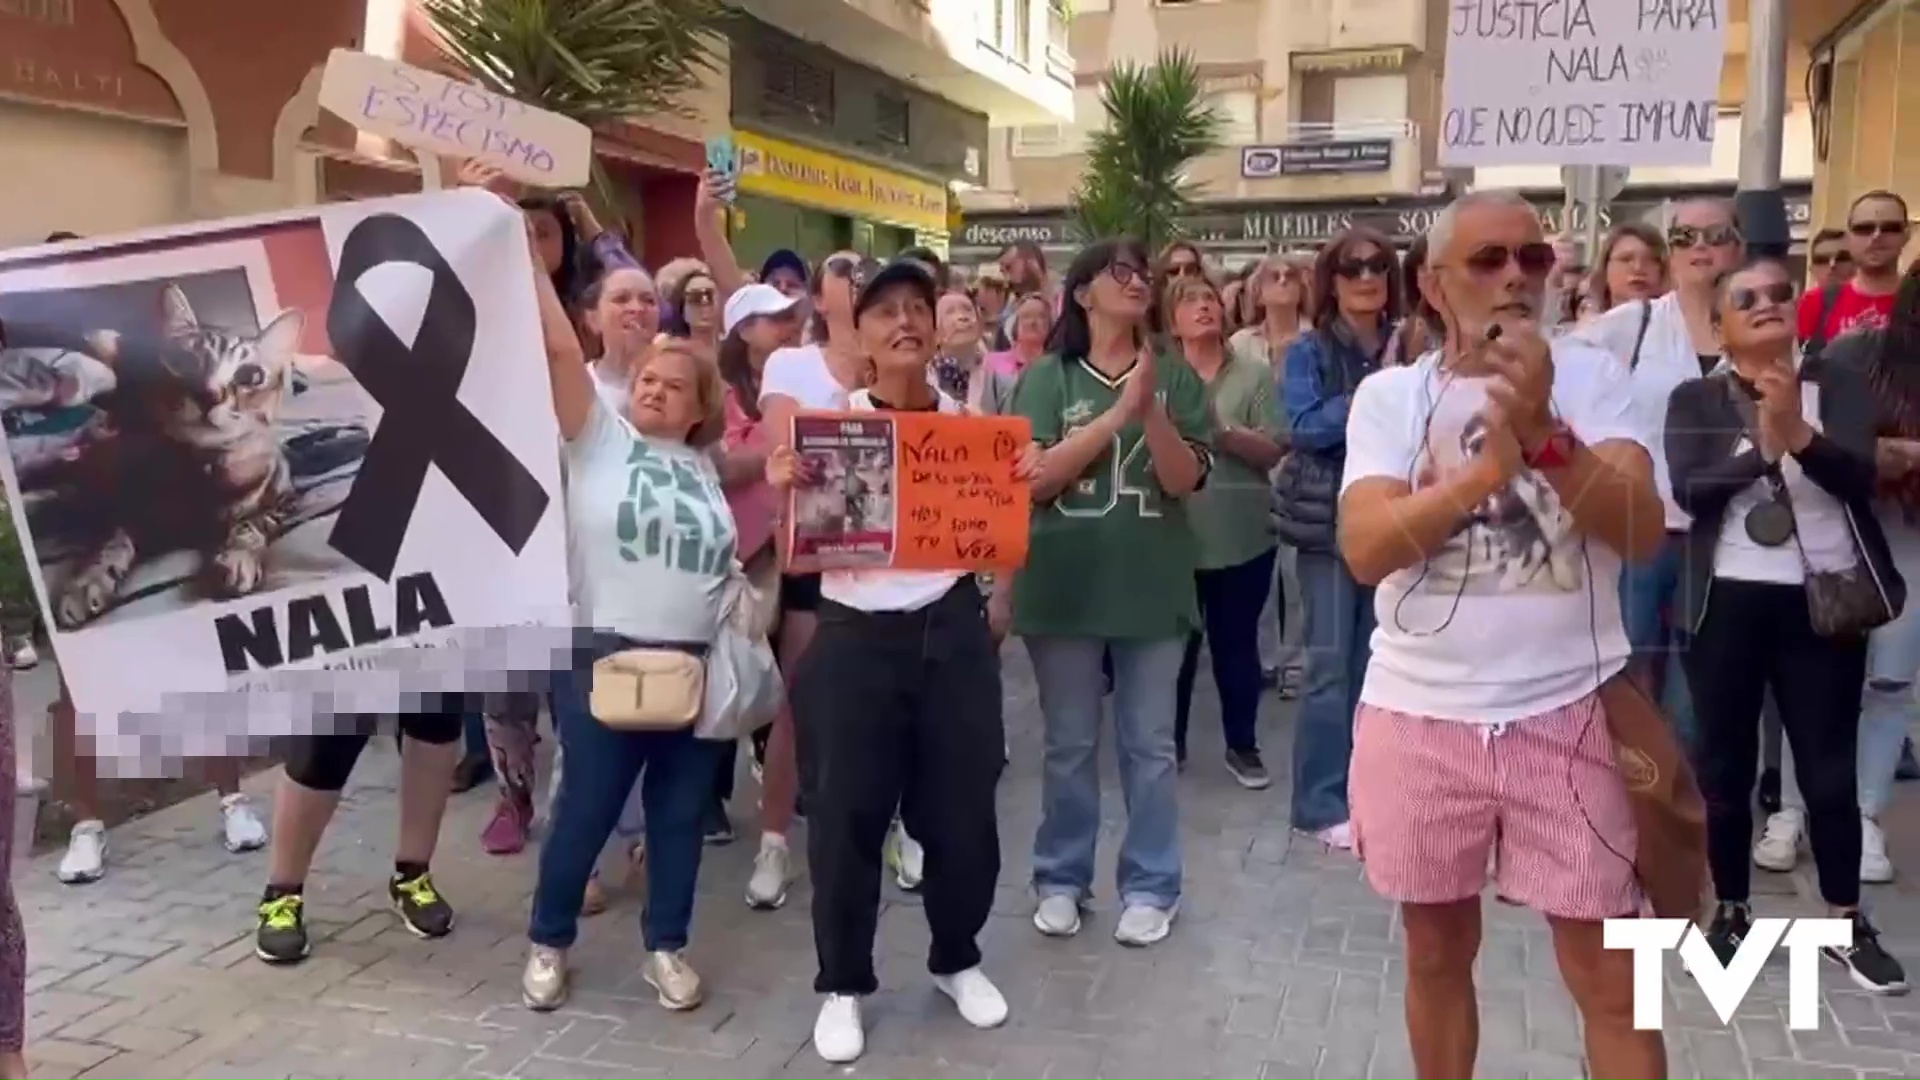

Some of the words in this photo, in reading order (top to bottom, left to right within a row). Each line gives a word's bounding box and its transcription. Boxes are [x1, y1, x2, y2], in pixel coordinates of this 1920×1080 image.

[1453, 0, 1595, 40] JUSTICIA
[1638, 0, 1717, 31] PARA
[1547, 43, 1629, 84] NALA
[361, 85, 555, 173] ESPECISMO
[1496, 106, 1532, 146] NO
[965, 223, 1052, 245] descanso
[1242, 209, 1352, 240] MUEBLES
[214, 571, 455, 672] NALA
